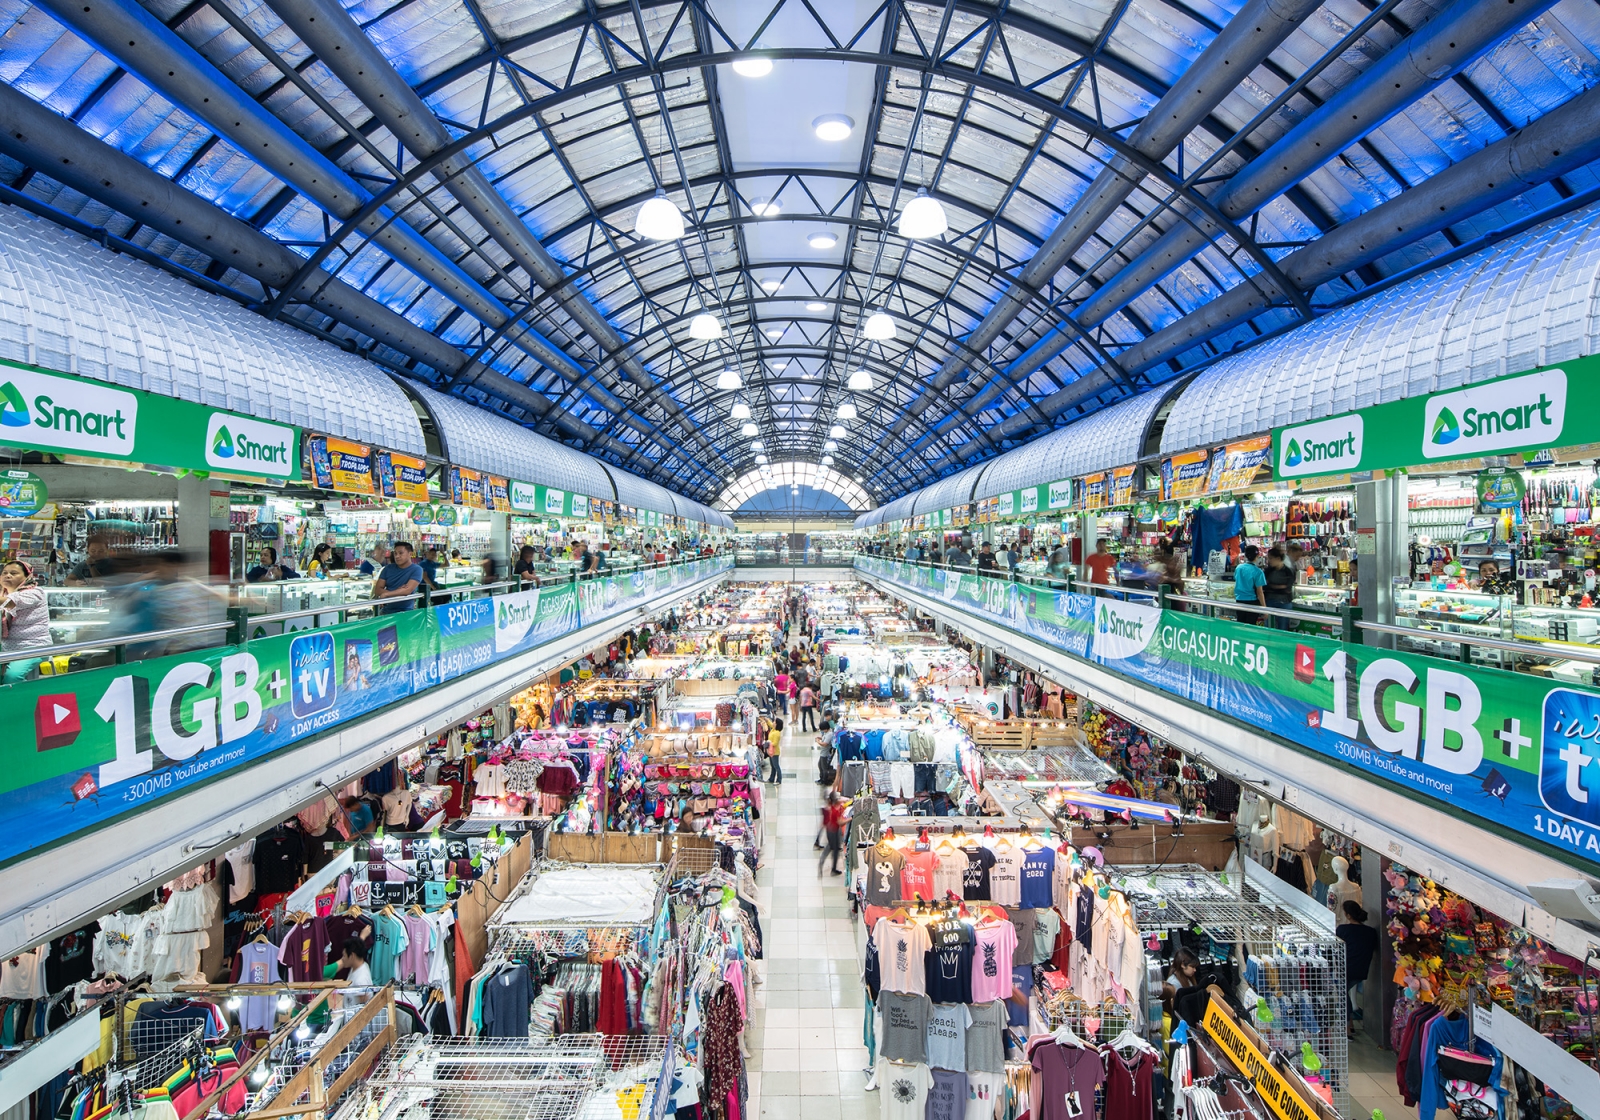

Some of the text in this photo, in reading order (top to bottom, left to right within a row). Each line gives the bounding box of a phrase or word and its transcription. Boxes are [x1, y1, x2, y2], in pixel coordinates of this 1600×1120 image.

[34, 395, 126, 440] Smart
[1462, 393, 1553, 438] Smart
[236, 433, 287, 465] Smart
[1303, 431, 1356, 462] Smart
[519, 490, 533, 505] Smart
[1055, 490, 1069, 501] Smart
[477, 602, 489, 615] days
[507, 600, 531, 624] Smart
[1110, 610, 1143, 643] Smart
[406, 643, 492, 687] Text GIGA50 to 9999
[1162, 625, 1269, 676] GIGASURF 50
[298, 667, 330, 704] tv
[94, 652, 263, 788] 1GB
[291, 710, 340, 738] 1 DAY ACCESS
[1321, 650, 1484, 774] 1GB
[122, 746, 246, 802] +300MB YouTube and more!
[1334, 741, 1453, 795] +300MB YouTube and more!
[1534, 814, 1545, 833] 1
[1547, 818, 1585, 847] DAY
[1022, 861, 1047, 871] KANYE
[354, 883, 370, 896] 100
[937, 921, 961, 932] FOR
[943, 933, 959, 944] 600
[928, 1026, 958, 1040] Please
[930, 1017, 957, 1029] Beach
[1209, 1012, 1248, 1061] CASUALINES
[1246, 1052, 1281, 1102] CLOTHING
